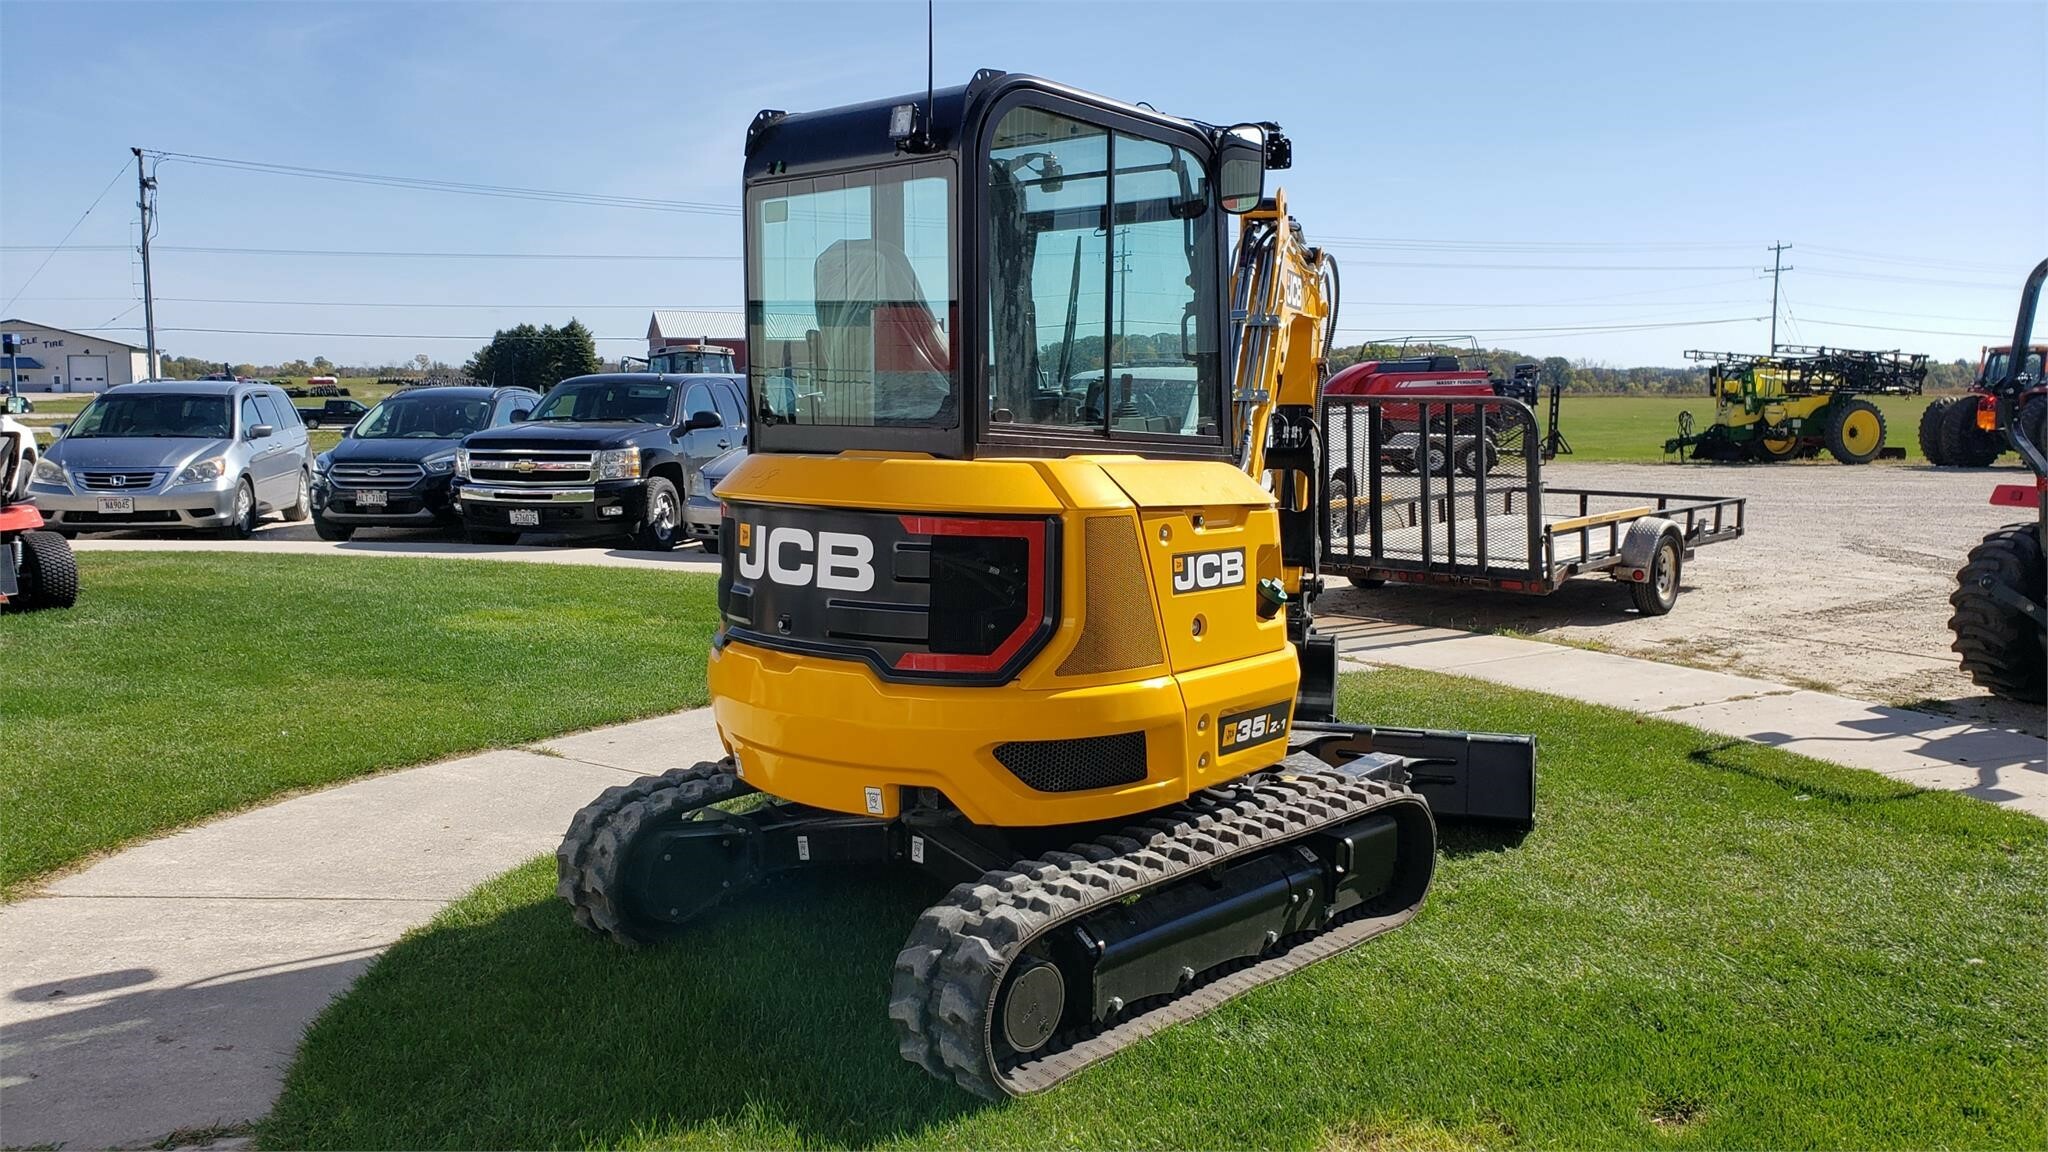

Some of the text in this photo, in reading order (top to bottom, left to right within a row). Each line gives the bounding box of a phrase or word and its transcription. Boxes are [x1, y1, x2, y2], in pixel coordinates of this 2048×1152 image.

[1287, 273, 1301, 307] JCB
[42, 339, 64, 349] TIRE
[738, 524, 876, 593] JCB
[1174, 551, 1244, 591] JCB
[1236, 714, 1267, 743] 35
